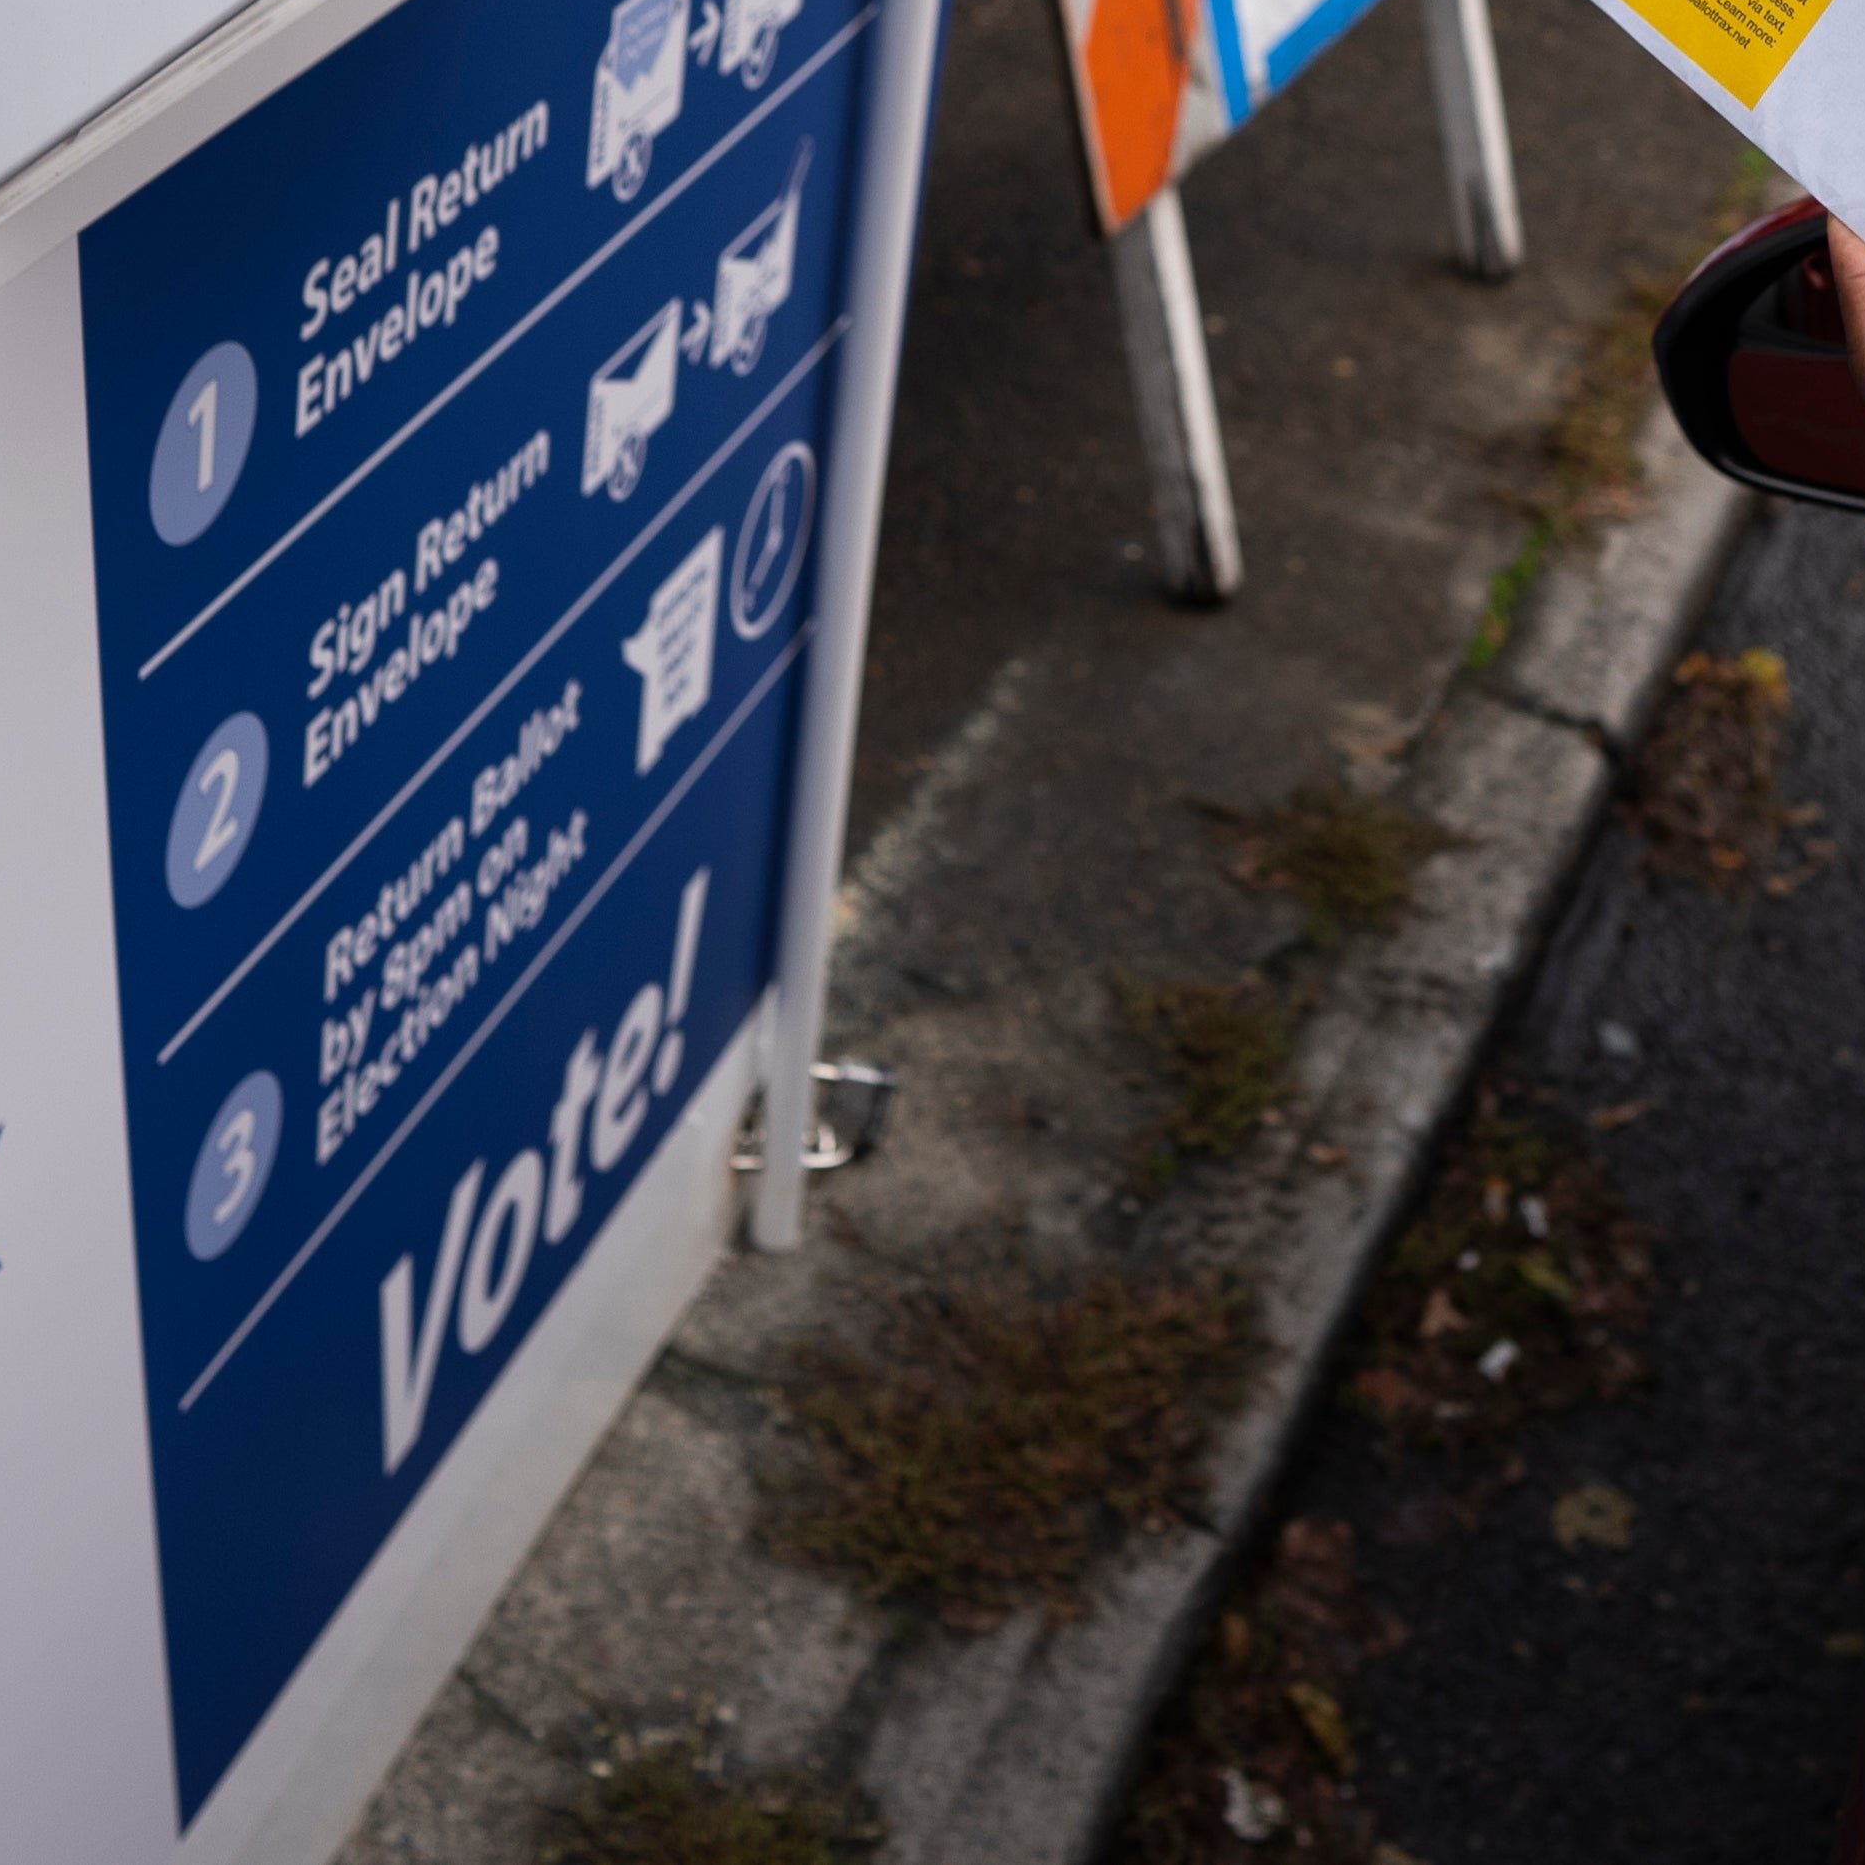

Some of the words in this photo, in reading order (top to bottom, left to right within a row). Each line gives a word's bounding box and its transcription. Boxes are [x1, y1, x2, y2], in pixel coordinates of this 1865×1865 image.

[1746, 19, 1777, 48] more:
[1763, 10, 1785, 35] text,
[295, 225, 500, 438] Envelope
[301, 197, 400, 342] Seal
[408, 100, 550, 253] Return
[187, 378, 218, 493] 1
[303, 558, 499, 789] Envelope
[307, 568, 406, 700] Sign
[414, 429, 550, 595] Return
[193, 746, 241, 875] 2
[324, 817, 464, 1003] Return
[471, 678, 582, 838] Ballot
[316, 945, 479, 1166] Election
[484, 808, 588, 963] Night
[319, 988, 375, 1086] by
[380, 881, 472, 1010] 8pm
[477, 817, 529, 898] on
[212, 1108, 257, 1224] 3
[379, 865, 710, 1476] Vote!
